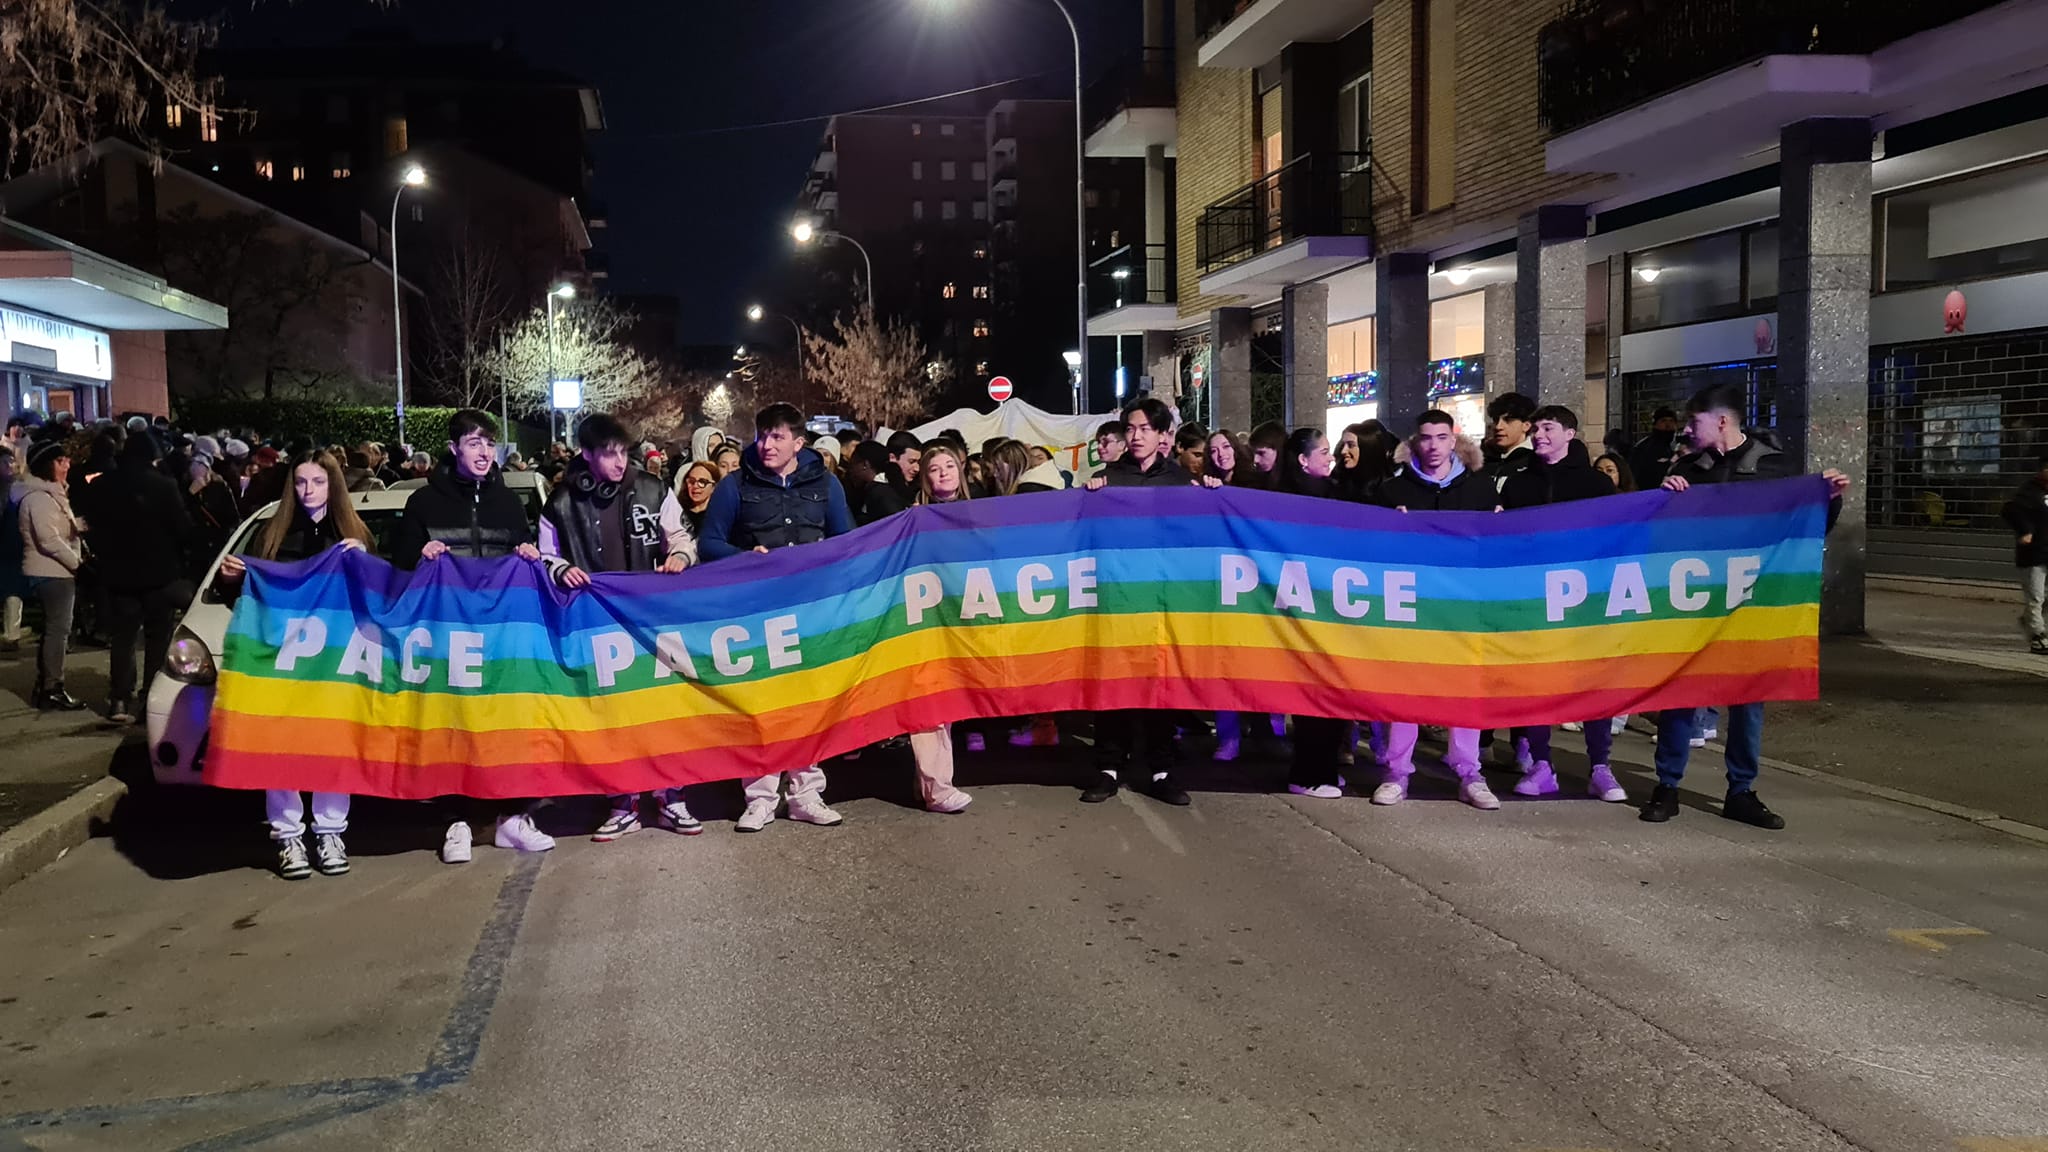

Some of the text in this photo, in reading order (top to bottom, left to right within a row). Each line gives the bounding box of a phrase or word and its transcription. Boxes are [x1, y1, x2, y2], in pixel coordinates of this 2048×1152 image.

[274, 553, 1761, 688] PACE PACE PACE PACE PACE
